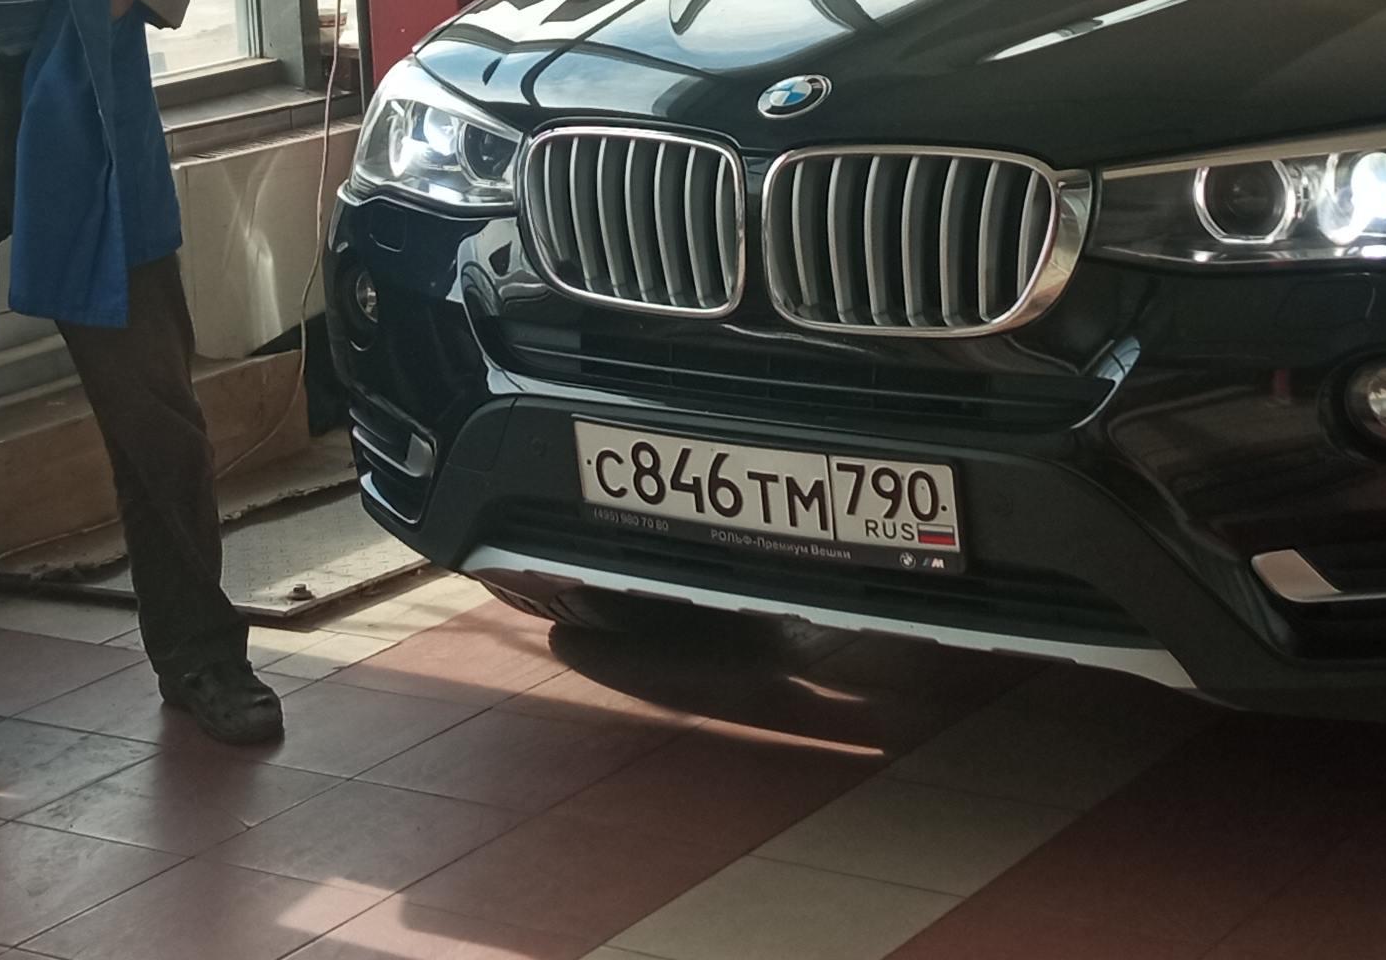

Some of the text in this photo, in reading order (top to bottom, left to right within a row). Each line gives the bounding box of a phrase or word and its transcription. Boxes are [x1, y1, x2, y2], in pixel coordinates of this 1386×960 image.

[595, 440, 940, 532] С846ТМ 790
[864, 518, 915, 541] RUS
